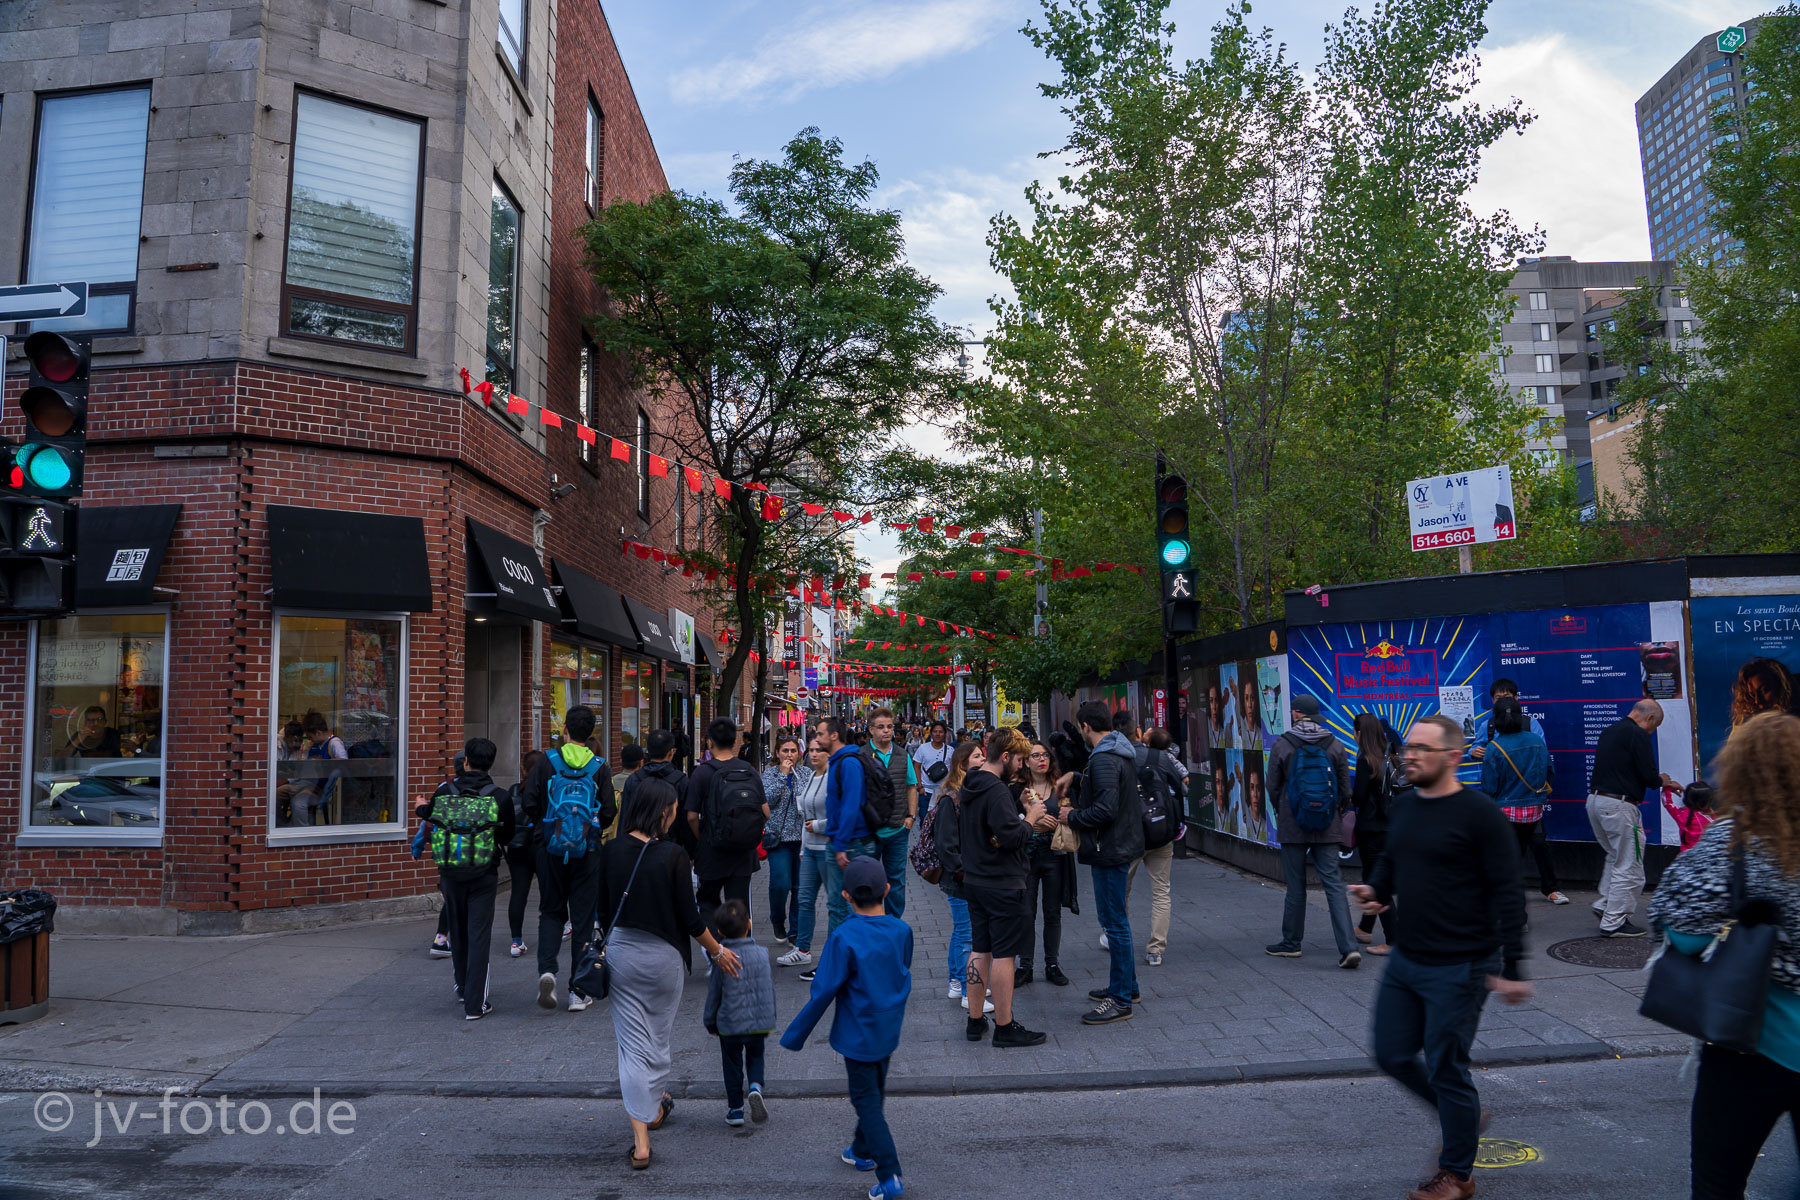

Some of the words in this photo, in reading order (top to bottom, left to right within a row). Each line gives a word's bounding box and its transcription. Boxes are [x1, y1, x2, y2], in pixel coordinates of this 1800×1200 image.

[1418, 516, 1449, 528] Jason
[1452, 512, 1466, 522] Yu
[502, 556, 534, 585] COCO
[1737, 606, 1751, 614] Les
[1714, 620, 1734, 634] EN
[1744, 618, 1800, 632] SPECTA
[1361, 660, 1385, 674] Red
[1386, 659, 1410, 672] Bull
[1344, 675, 1378, 688] Music
[1380, 673, 1430, 687] Festival
[1364, 691, 1410, 700] MONTRÉAL
